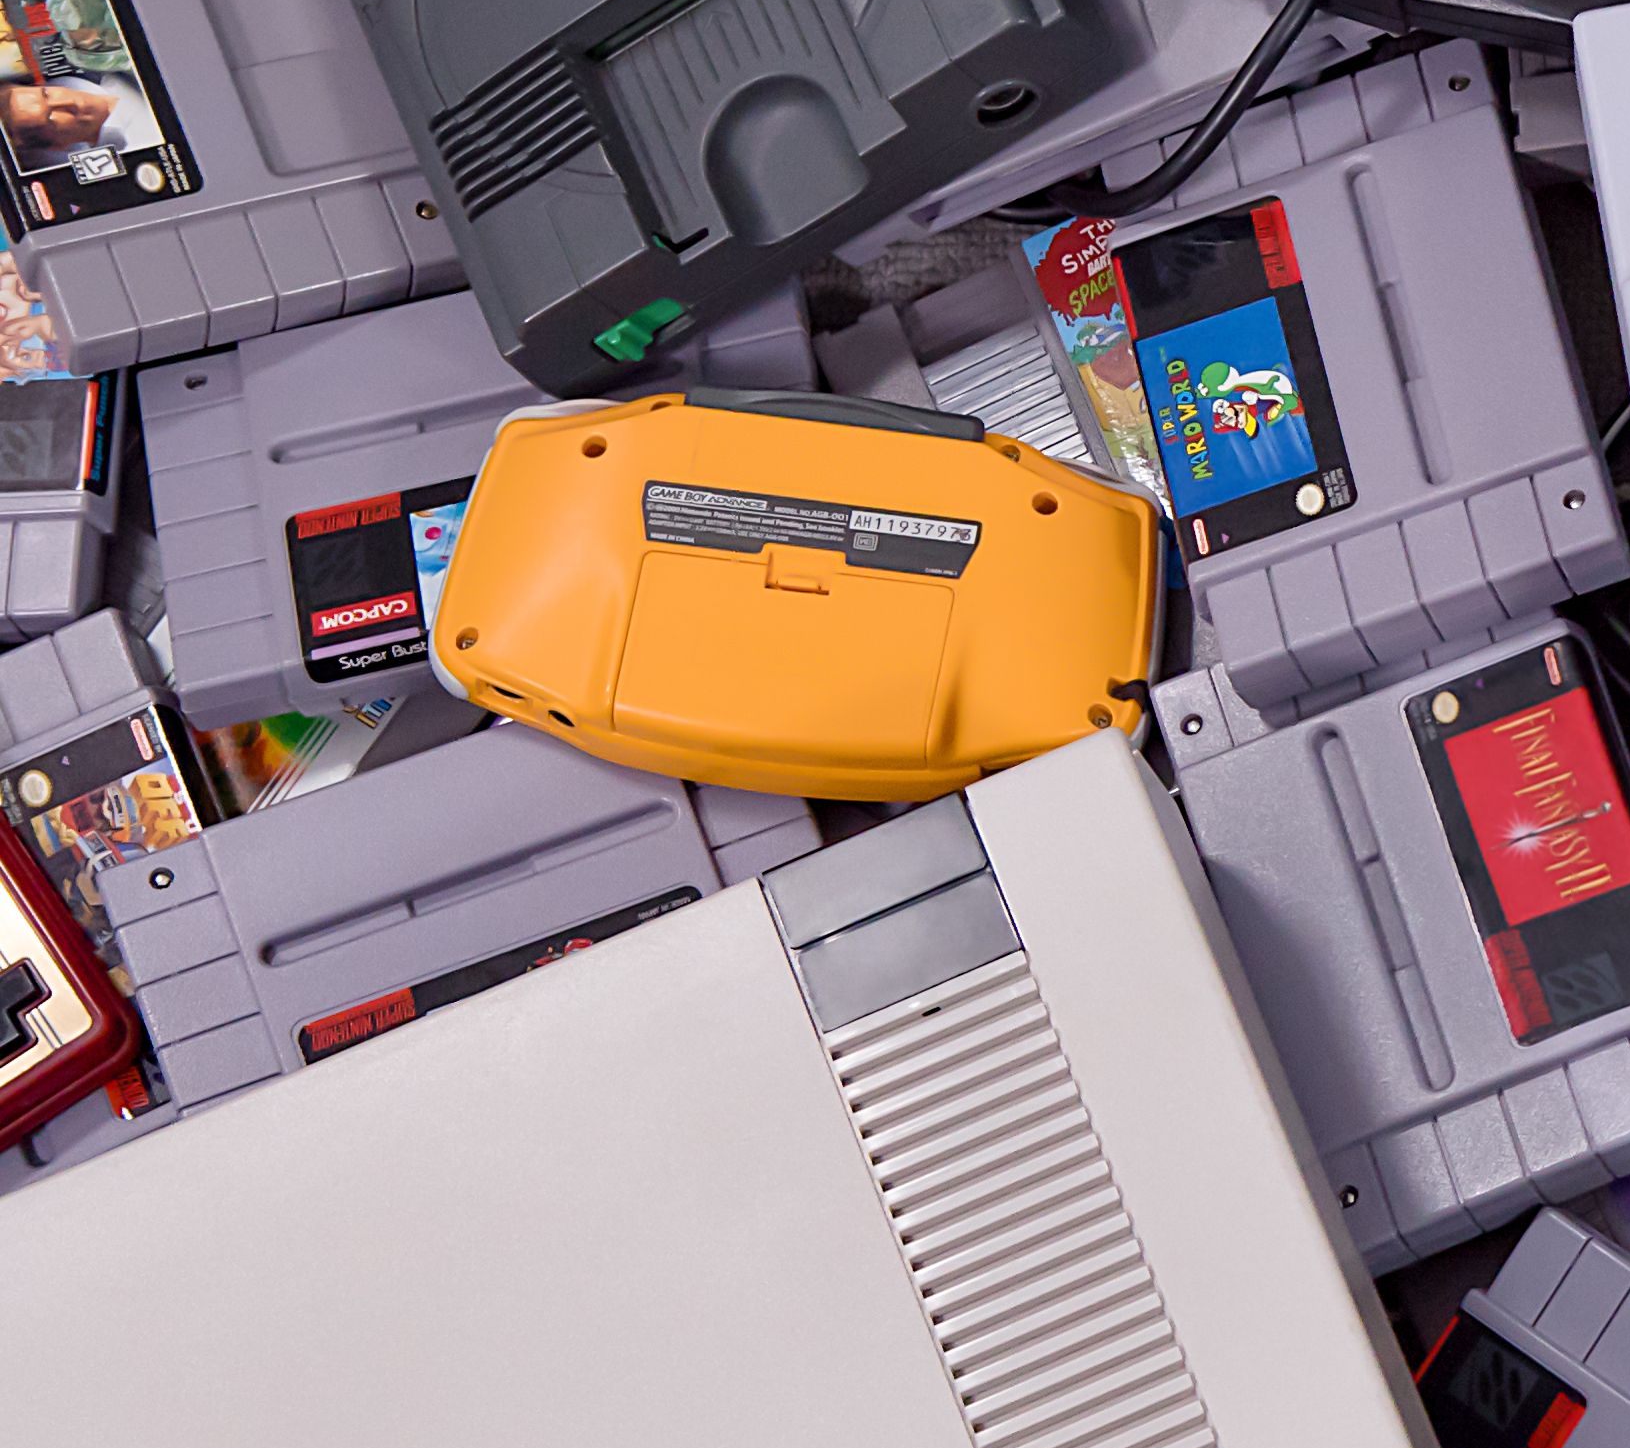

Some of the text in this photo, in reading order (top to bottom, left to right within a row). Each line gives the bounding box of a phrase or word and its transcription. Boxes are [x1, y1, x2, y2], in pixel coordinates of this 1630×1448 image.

[1168, 359, 1213, 482] MARIO WORLD
[321, 600, 407, 629] CAPCOM
[1495, 708, 1562, 791] FINAL
[1537, 776, 1600, 871] FANTASY
